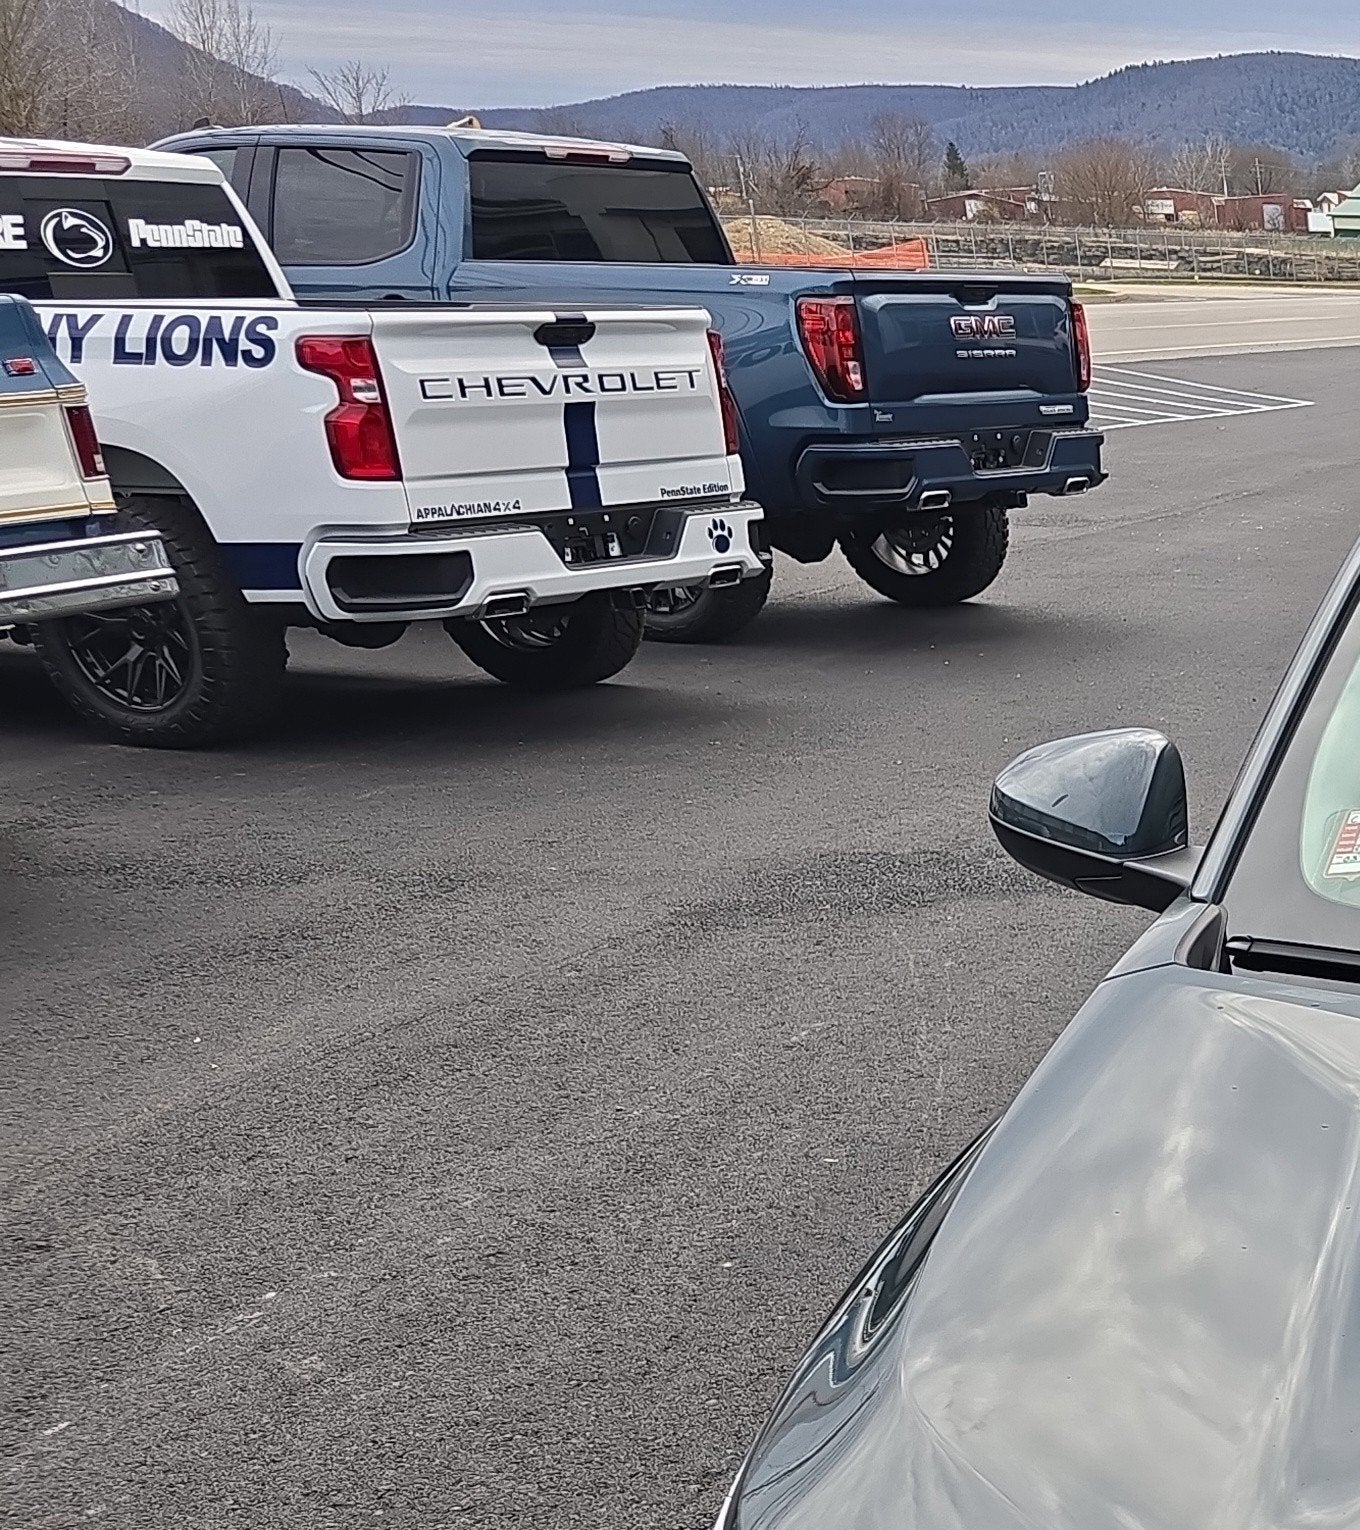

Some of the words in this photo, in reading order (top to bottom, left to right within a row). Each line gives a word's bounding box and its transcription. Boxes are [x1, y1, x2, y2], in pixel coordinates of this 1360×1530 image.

[112, 313, 279, 368] LIONS
[950, 315, 1017, 340] GMC
[418, 368, 701, 400] CHEVROLET
[702, 481, 729, 494] Edition
